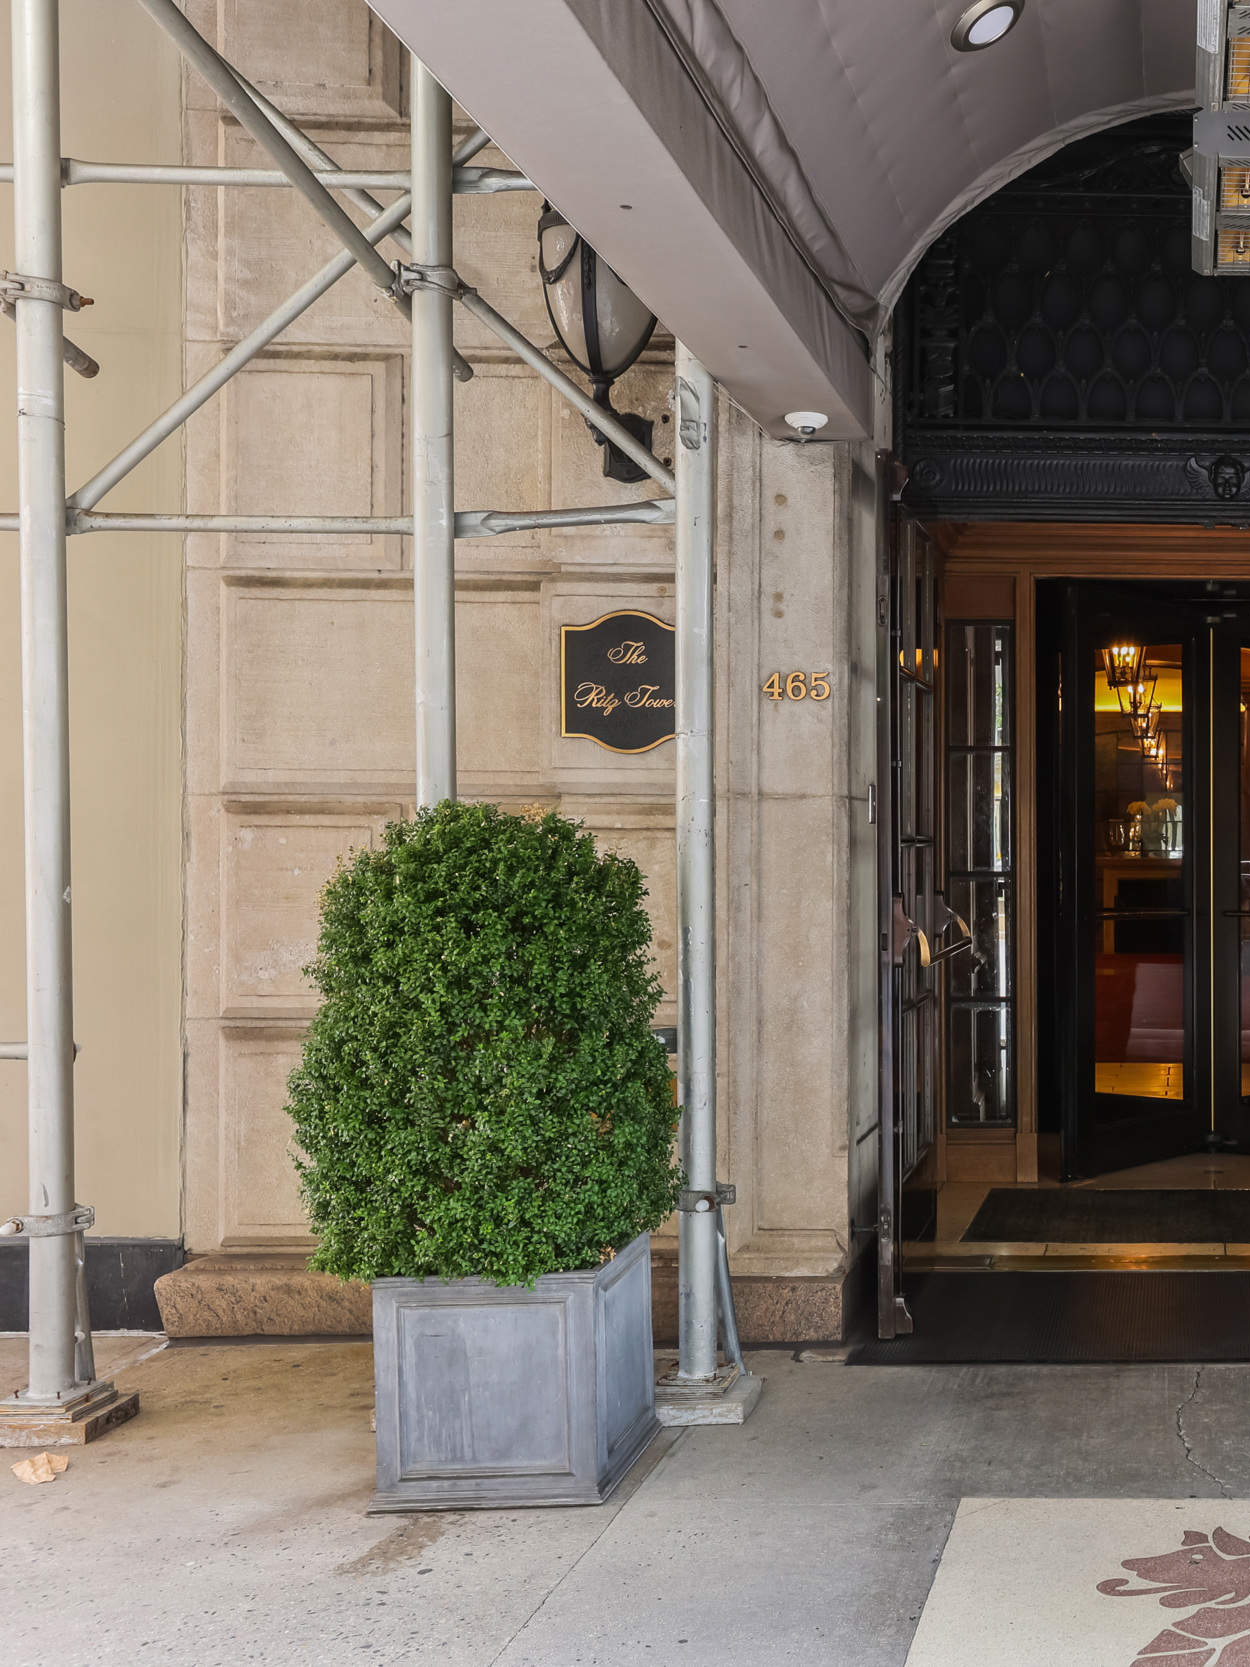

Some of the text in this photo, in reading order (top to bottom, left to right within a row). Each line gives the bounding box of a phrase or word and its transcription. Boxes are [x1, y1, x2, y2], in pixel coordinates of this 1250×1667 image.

[607, 640, 648, 664] The
[574, 681, 622, 716] Ritz
[762, 671, 831, 700] 465
